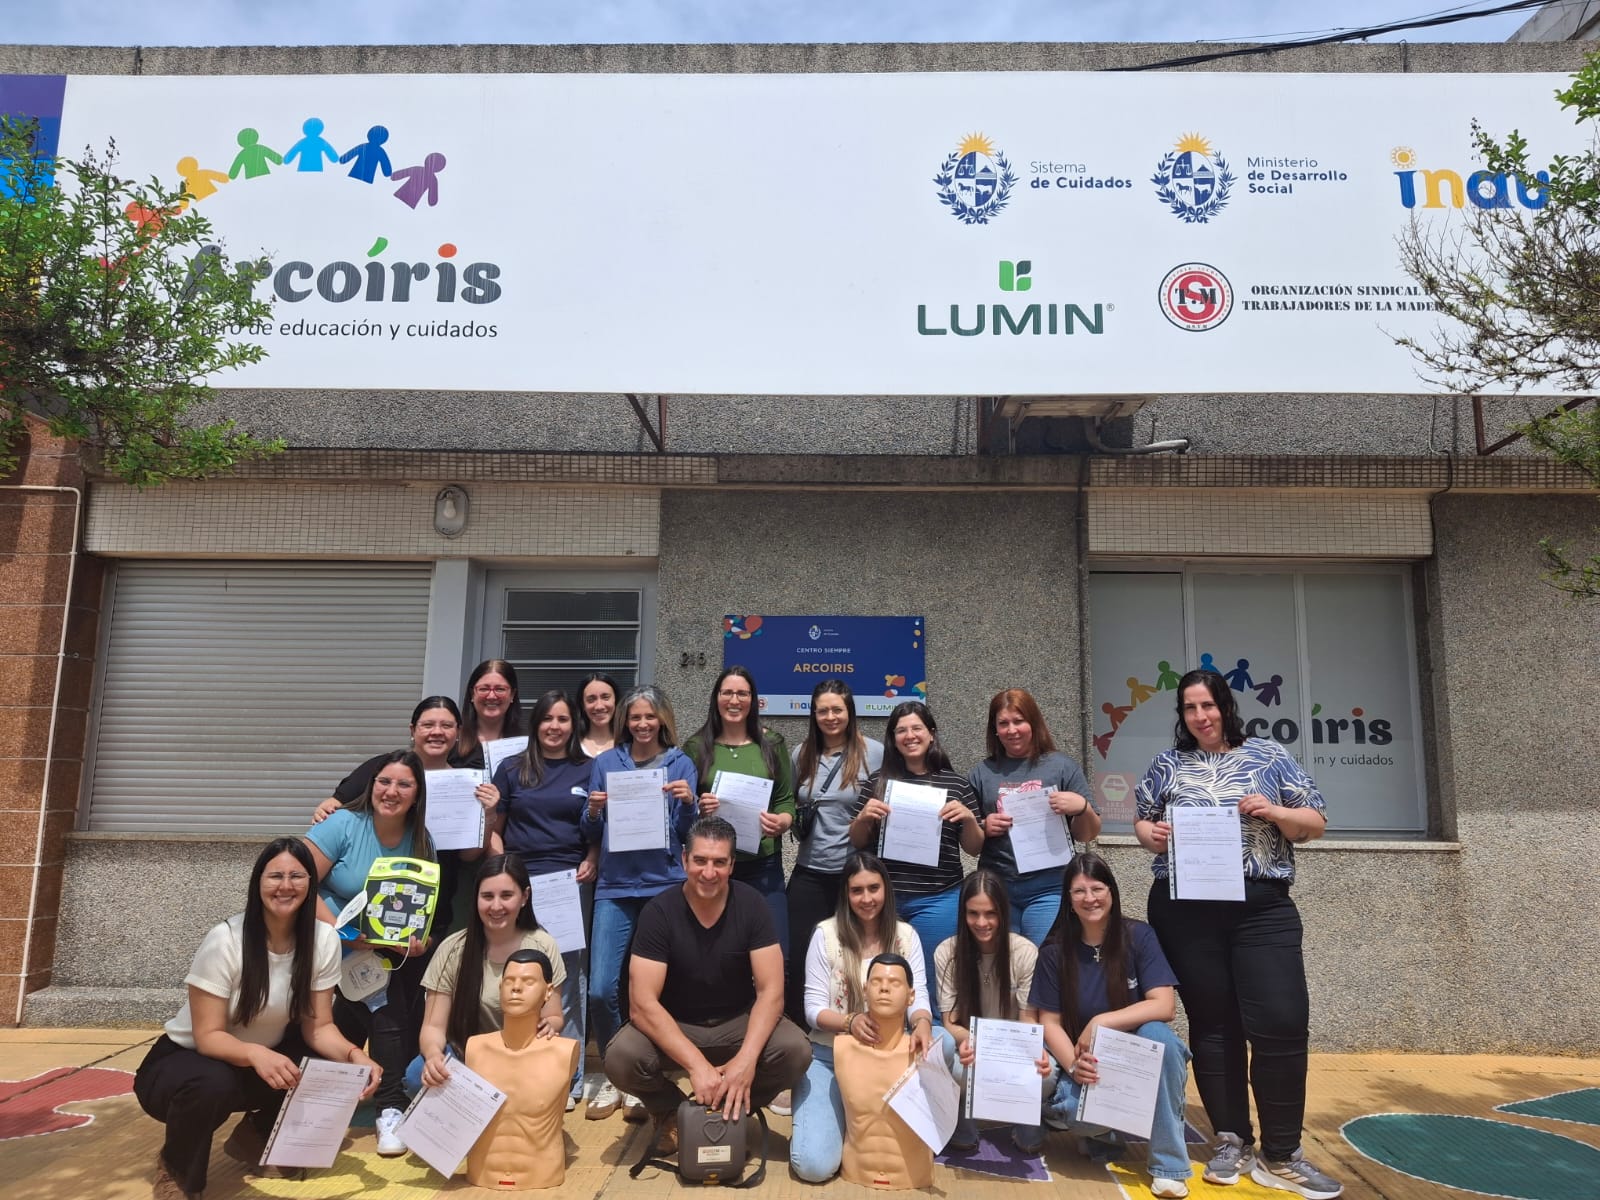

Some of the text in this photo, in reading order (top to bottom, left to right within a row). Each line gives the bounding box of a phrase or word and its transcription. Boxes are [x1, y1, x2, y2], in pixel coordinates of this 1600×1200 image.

[1029, 160, 1086, 174] Sistema
[1247, 156, 1319, 168] Ministerio
[1247, 169, 1348, 182] de Desarrollo
[1030, 176, 1133, 189] de Cuidados
[1248, 182, 1294, 194] Social
[1250, 284, 1353, 296] ORGANIZACIÓN
[1357, 285, 1421, 296] SINDICAL
[1242, 300, 1350, 311] TRABAJADORES
[1354, 301, 1373, 311] DE
[1376, 301, 1393, 311] LA
[248, 317, 273, 336] de
[279, 318, 382, 337] educación
[389, 323, 400, 341] y
[406, 319, 498, 338] cuidados
[793, 663, 855, 673] ARCOIRIS
[1329, 756, 1336, 768] y
[1340, 754, 1394, 766] cuidados
